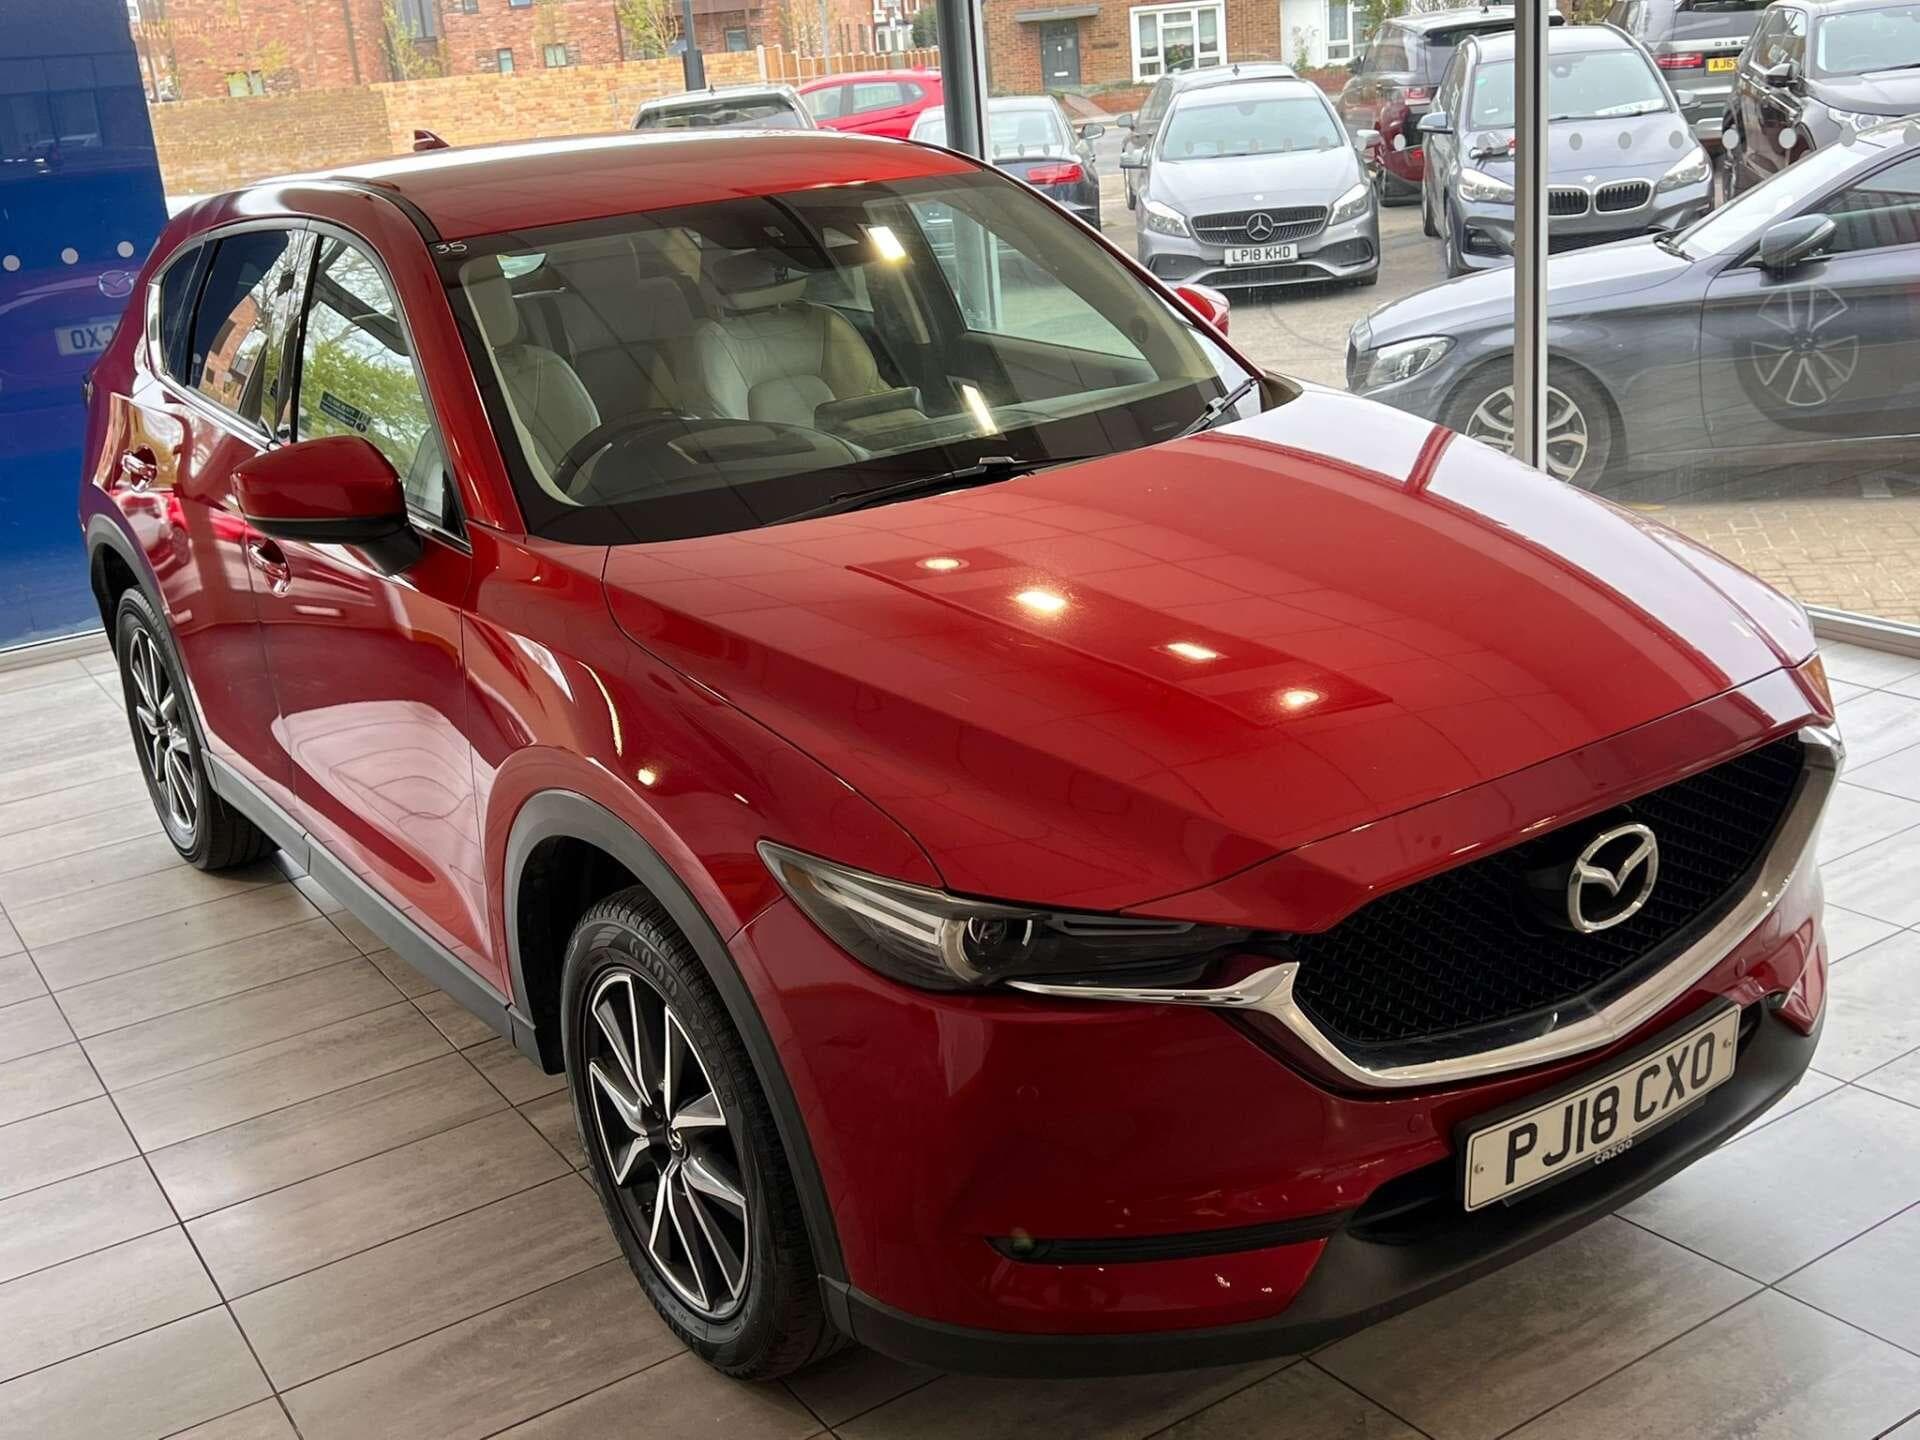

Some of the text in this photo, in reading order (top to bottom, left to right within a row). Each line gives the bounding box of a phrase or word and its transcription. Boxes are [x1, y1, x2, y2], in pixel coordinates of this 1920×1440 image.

[436, 240, 468, 254] 35
[1232, 245, 1291, 263] LP18 KHD
[1504, 1031, 1716, 1186] PJ18 CXO
